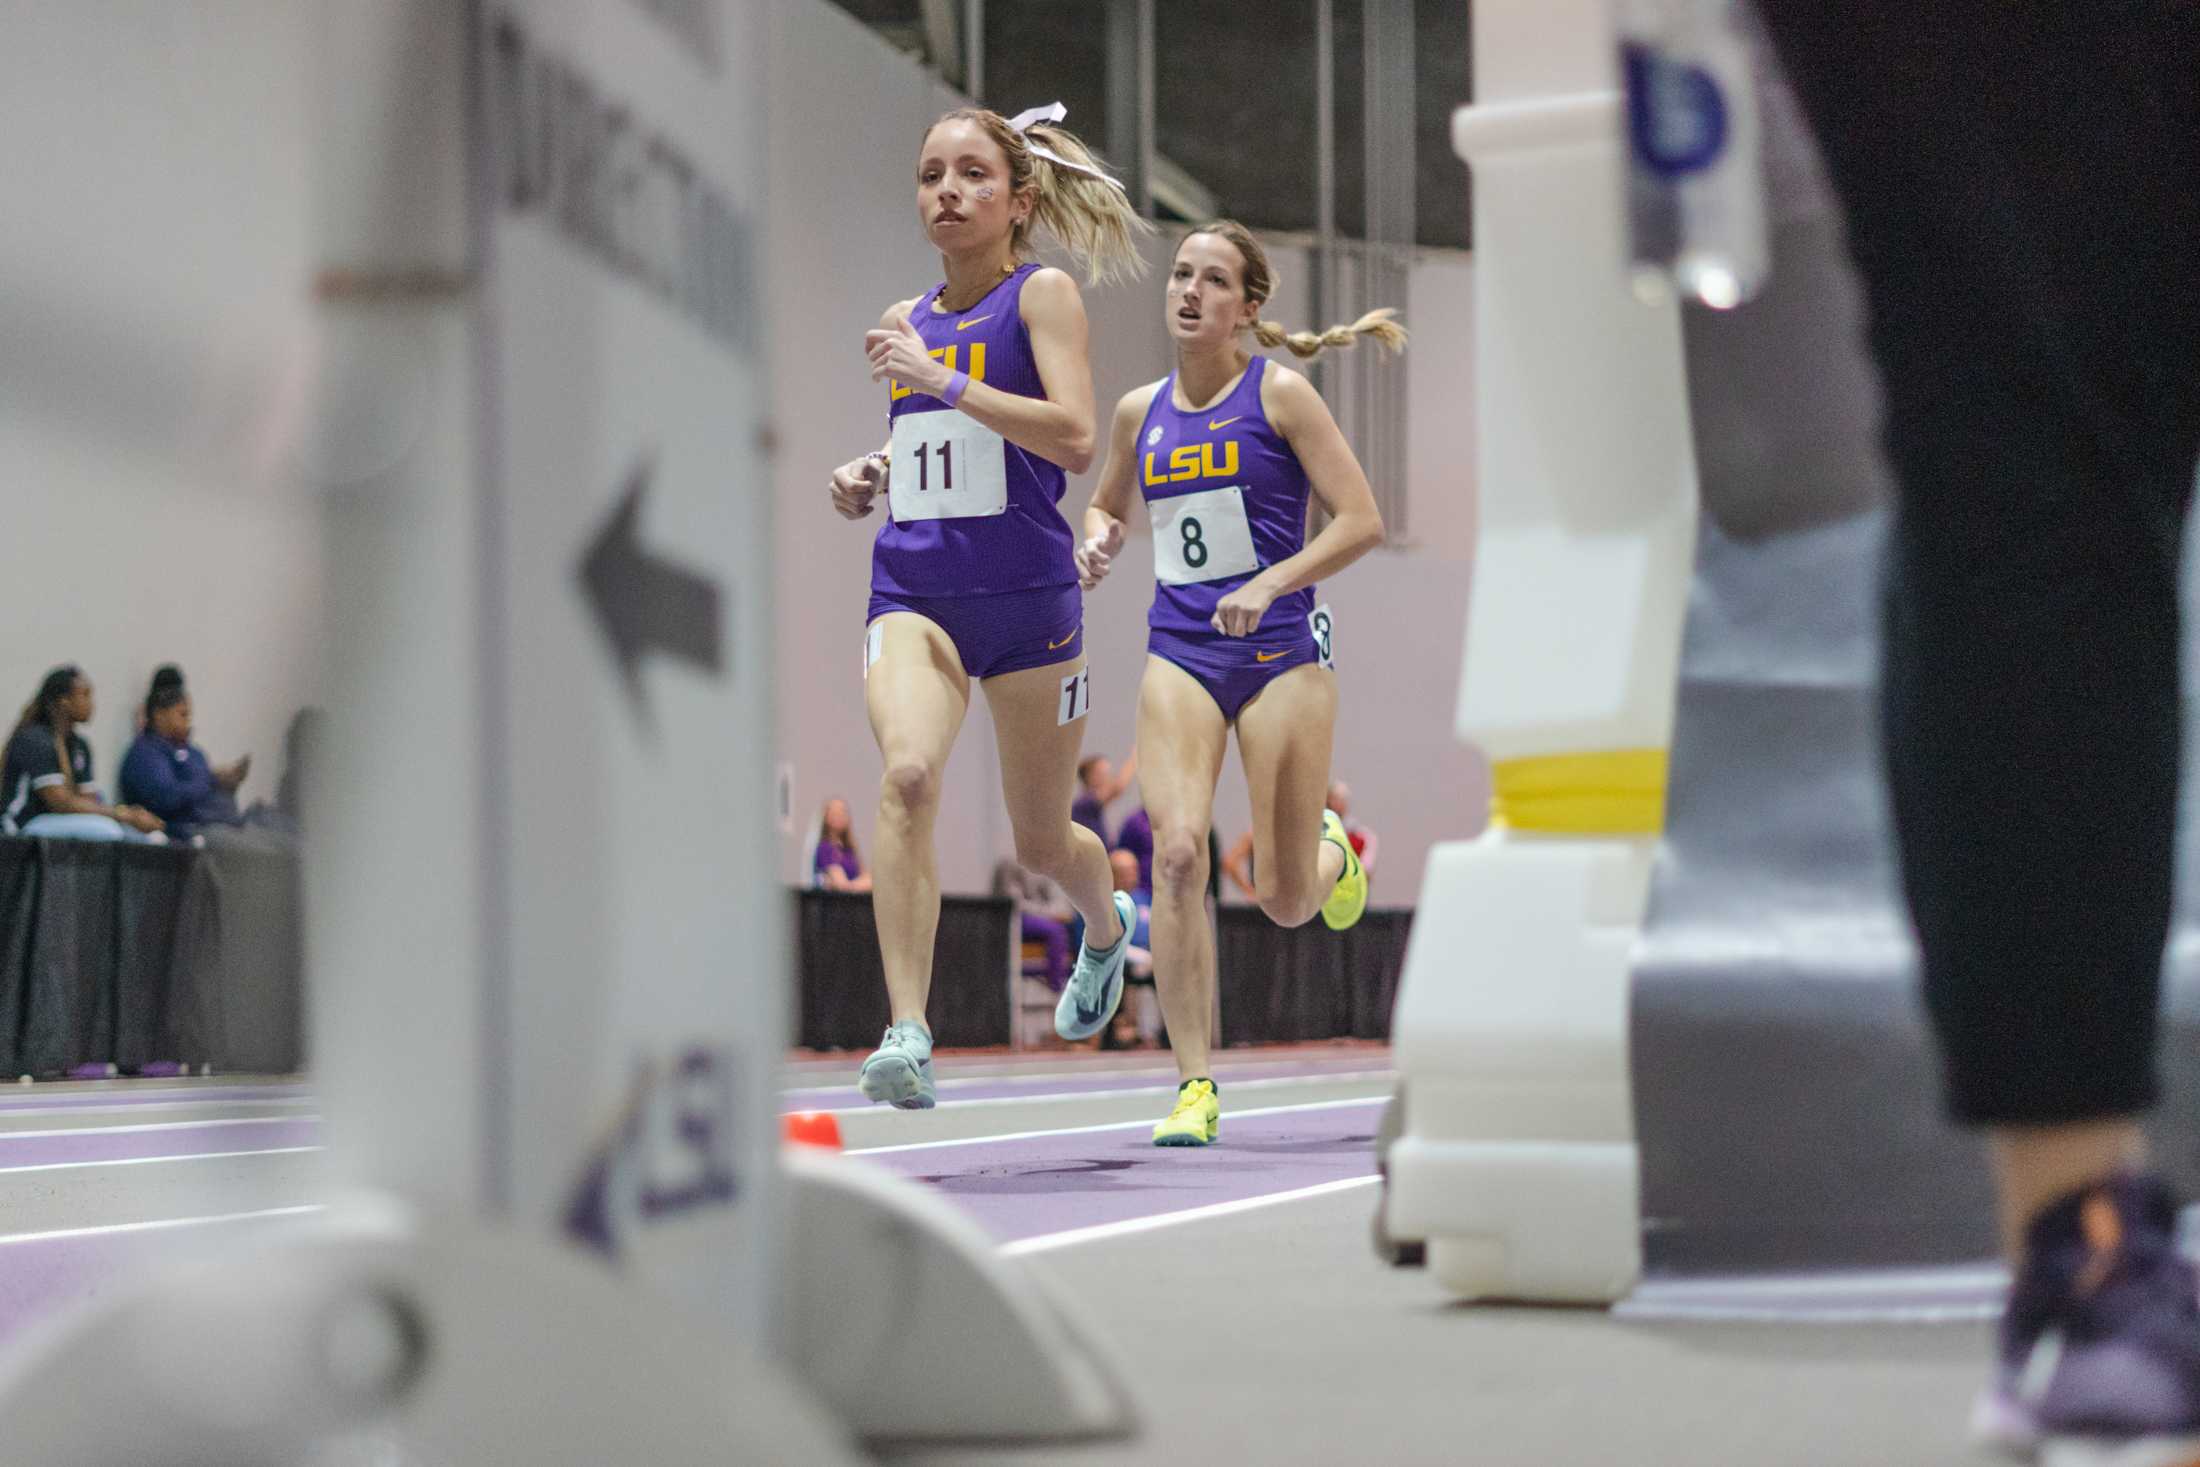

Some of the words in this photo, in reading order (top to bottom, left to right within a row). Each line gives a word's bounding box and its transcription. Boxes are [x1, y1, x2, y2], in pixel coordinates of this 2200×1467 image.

[913, 440, 952, 491] 11
[1144, 440, 1240, 487] LSU
[1180, 517, 1208, 568] 8
